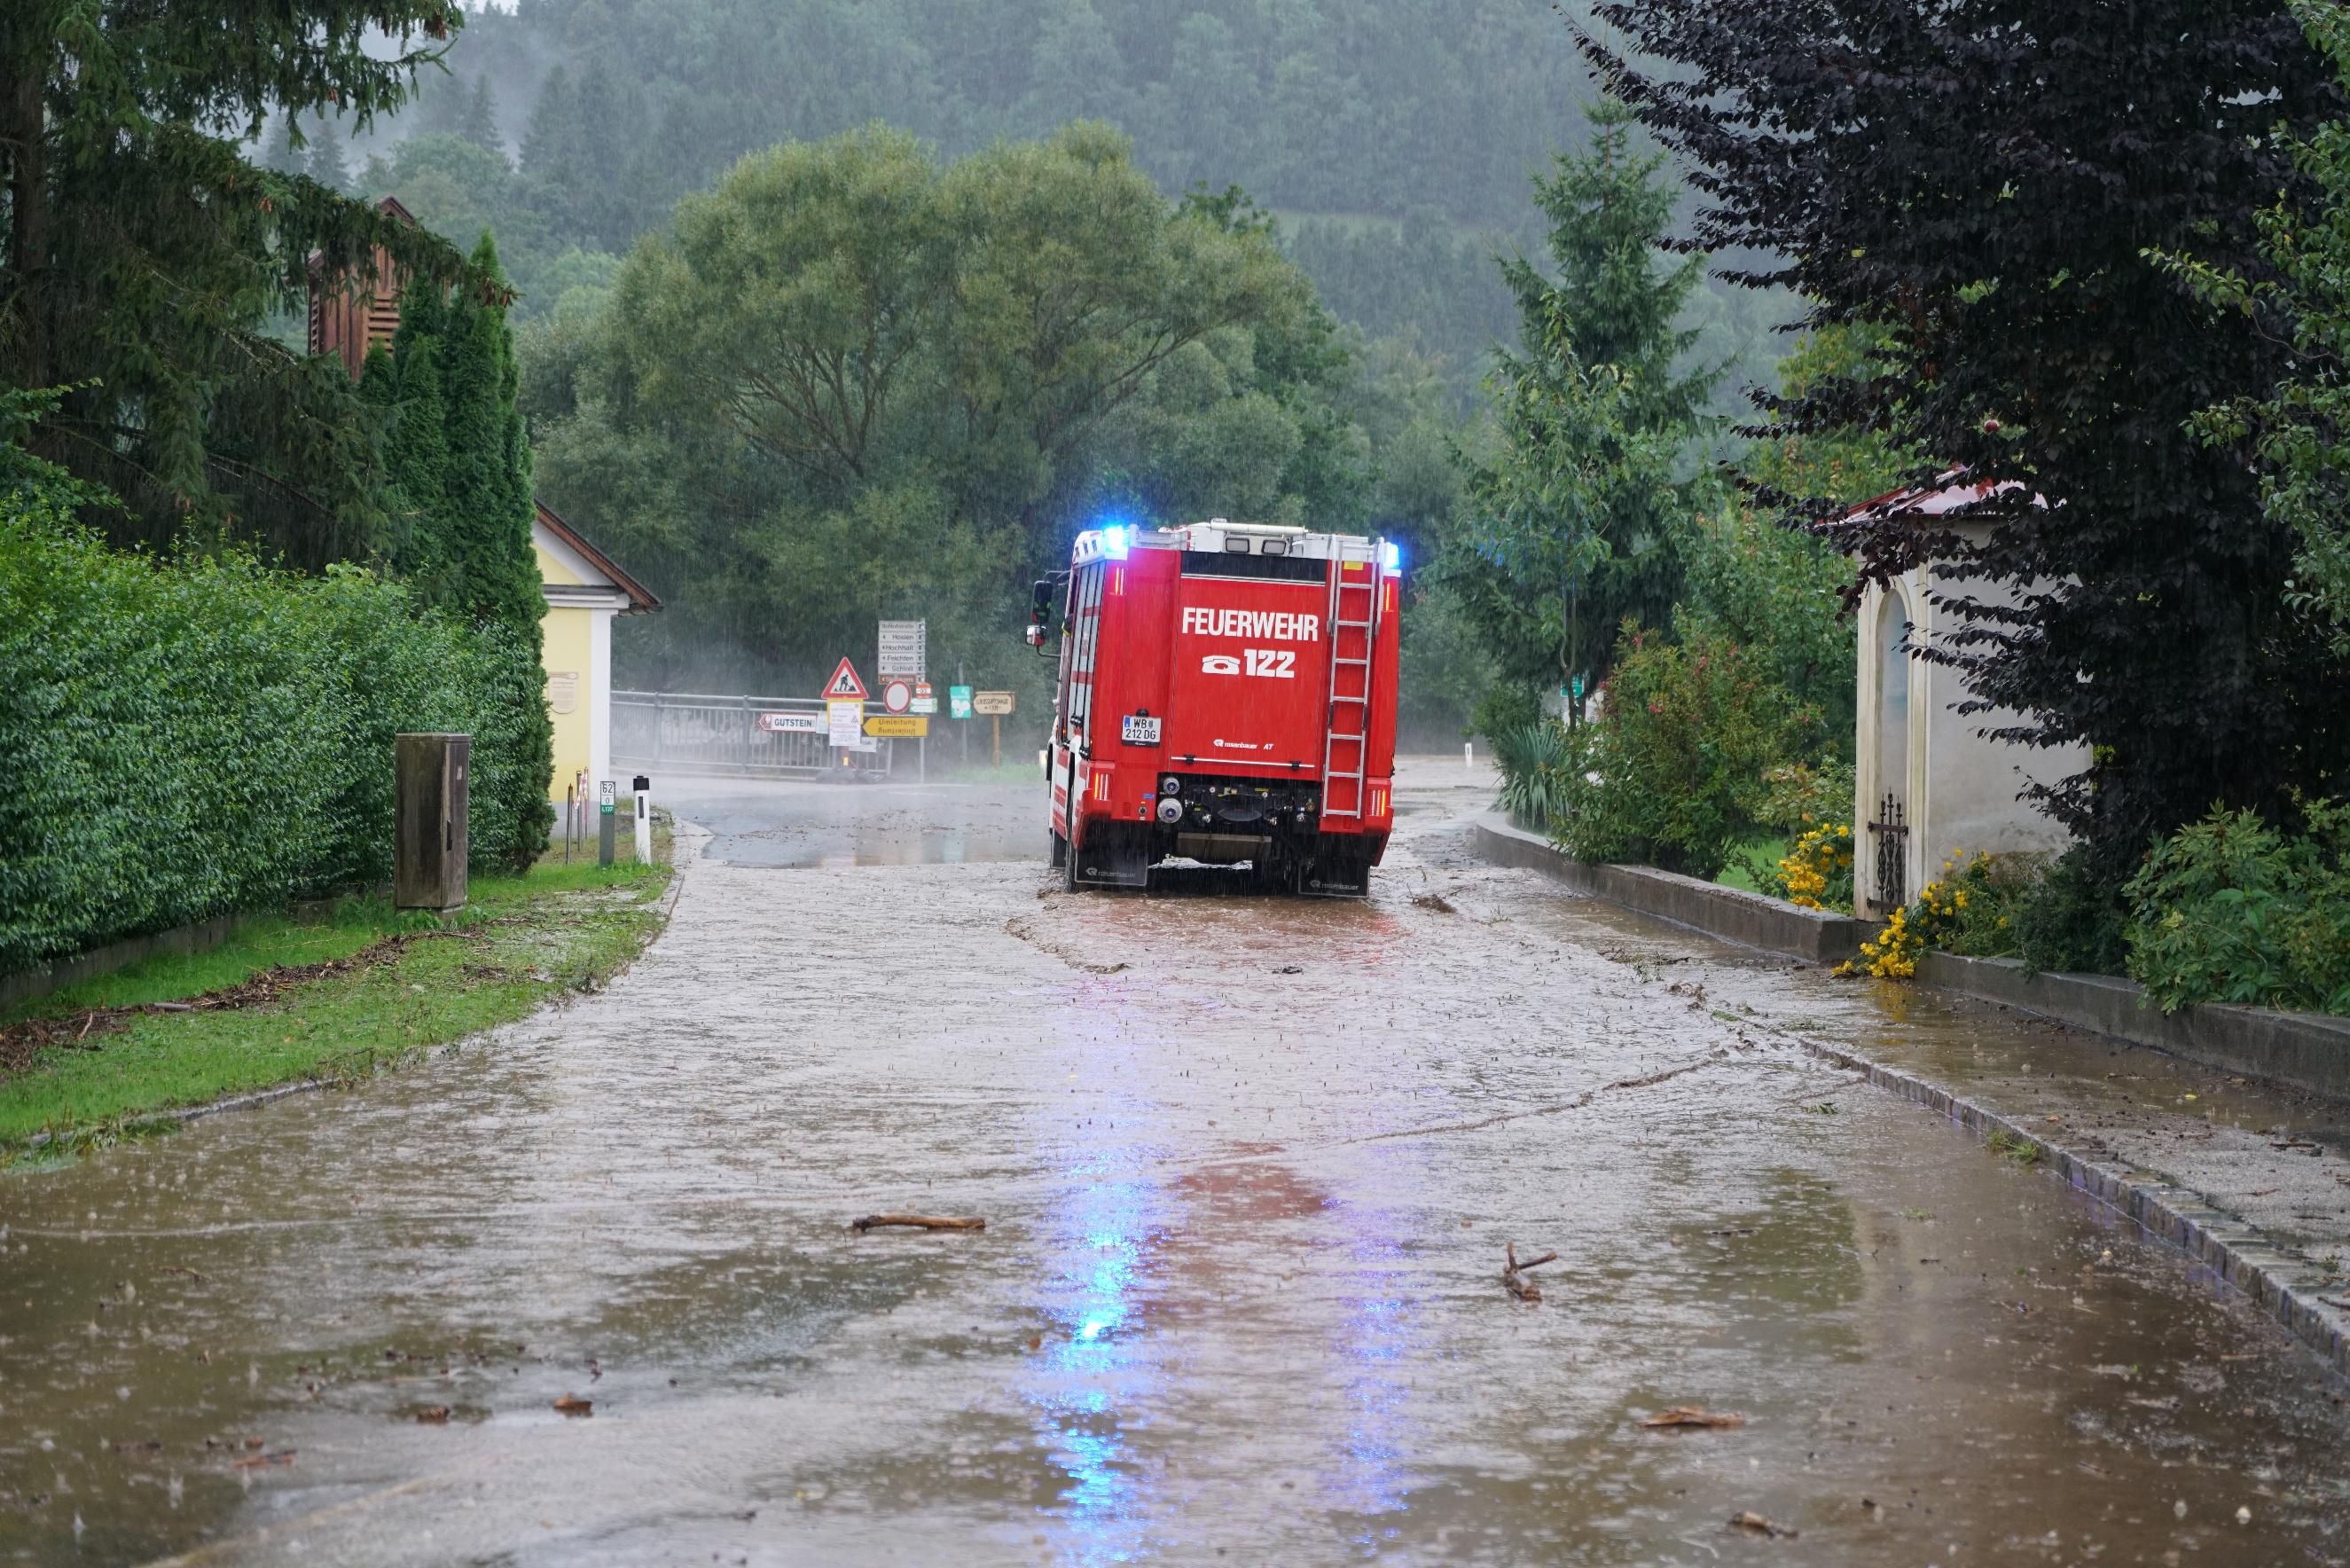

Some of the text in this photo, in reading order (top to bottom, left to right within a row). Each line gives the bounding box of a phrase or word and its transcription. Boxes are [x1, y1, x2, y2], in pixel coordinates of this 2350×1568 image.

[1182, 607, 1319, 642] FEUERWEHR
[1244, 648, 1296, 678] 122
[774, 718, 812, 727] GUTSTEIN
[878, 718, 916, 727] Umleitung
[1134, 718, 1147, 729] WB
[1126, 729, 1156, 739] 212 DG
[603, 784, 613, 793] 62
